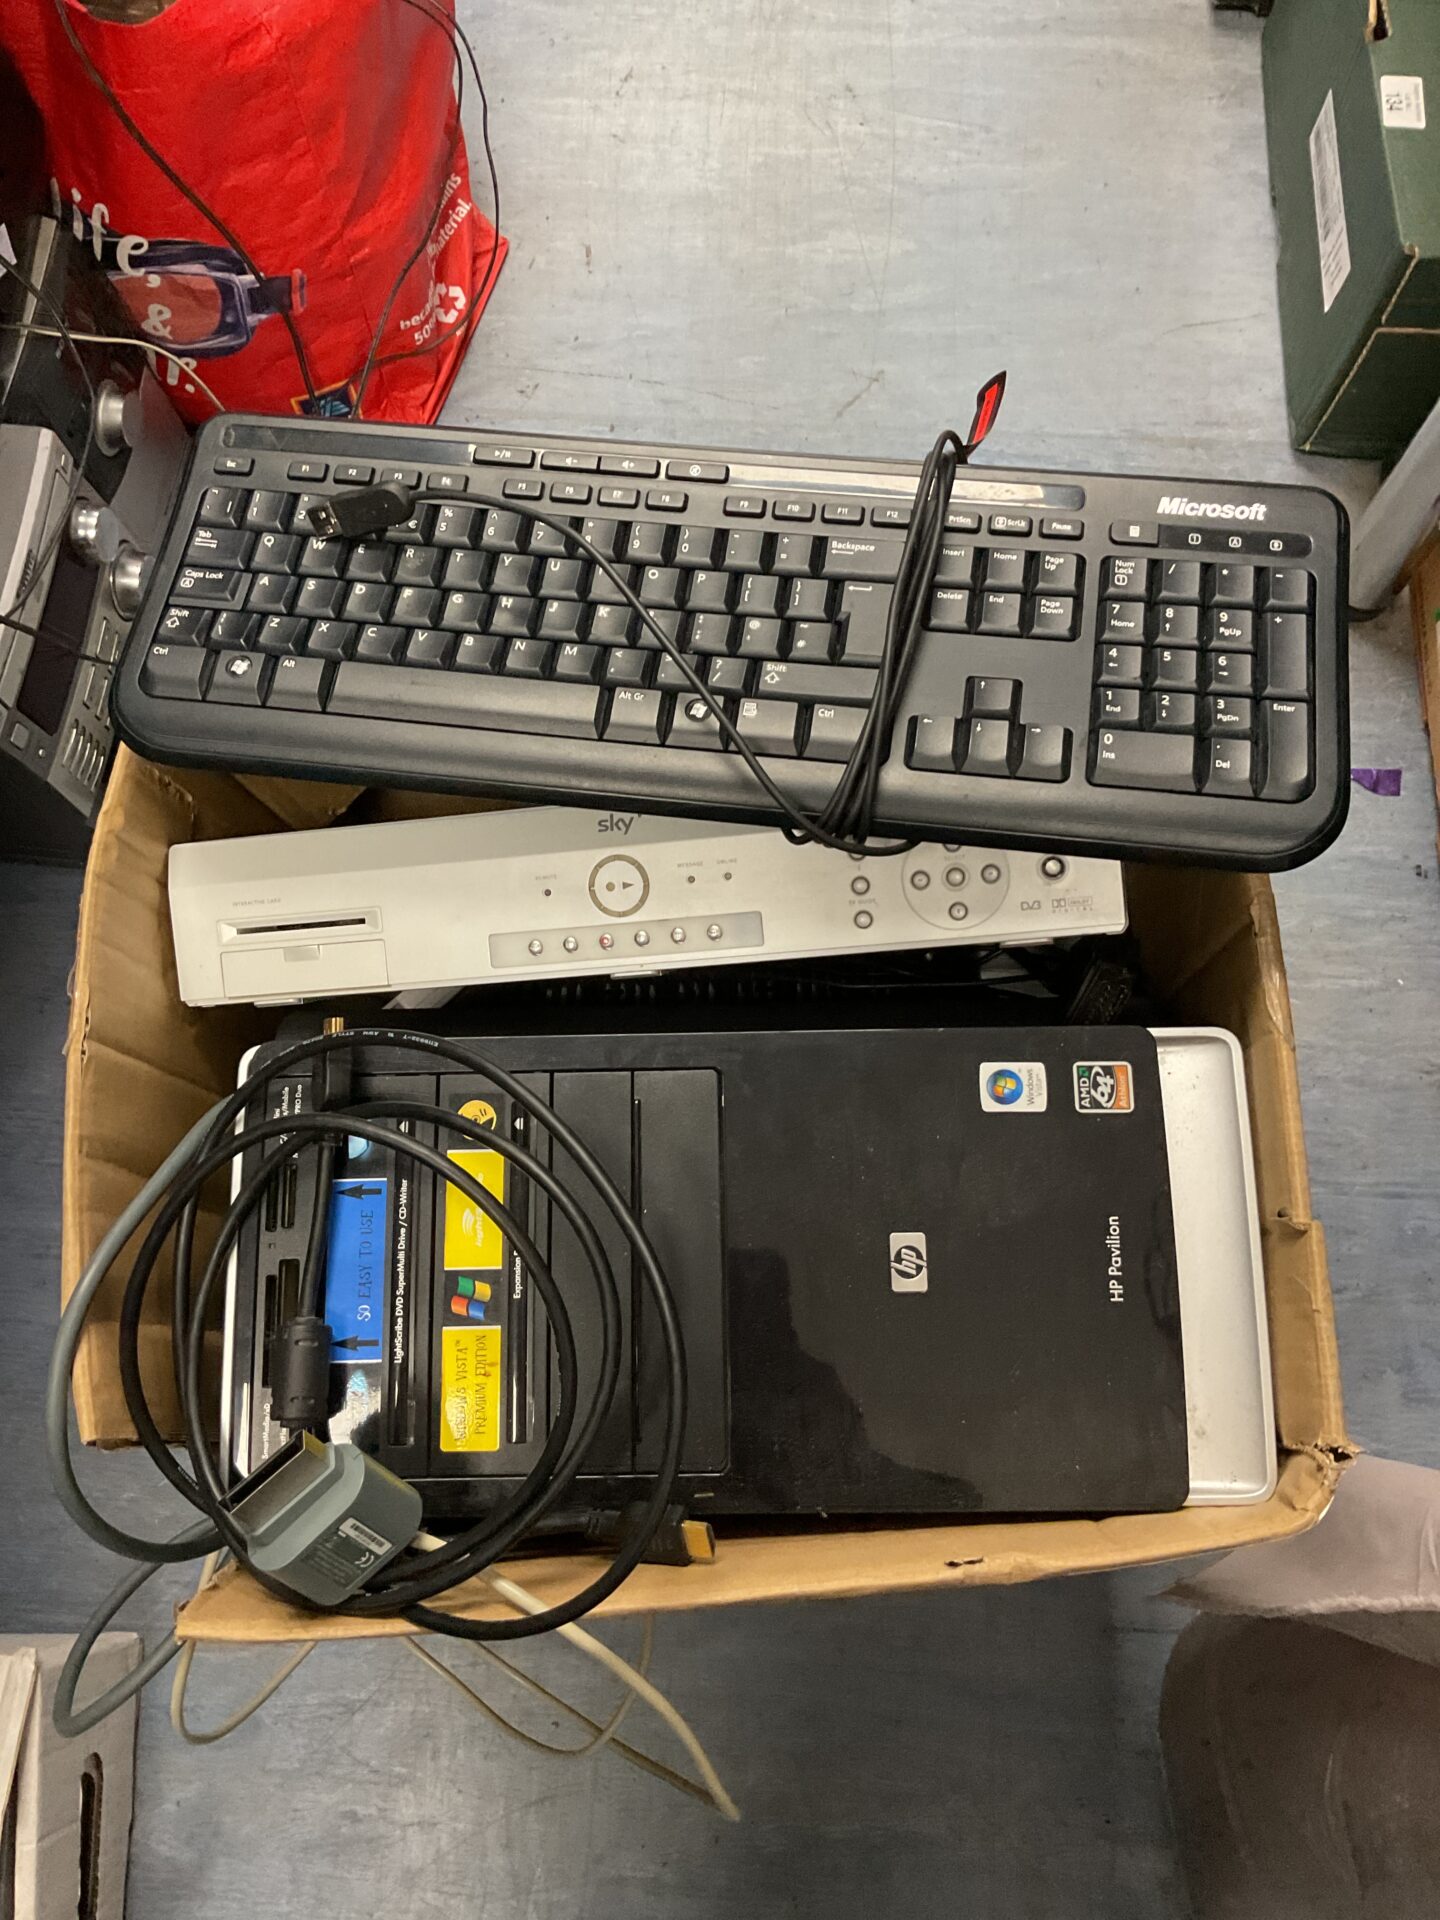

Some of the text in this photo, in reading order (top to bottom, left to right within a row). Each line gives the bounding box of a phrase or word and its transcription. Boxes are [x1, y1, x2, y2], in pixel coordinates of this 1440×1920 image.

[442, 477, 450, 485] F4
[444, 508, 454, 518] %
[787, 504, 800, 513] F10
[837, 507, 848, 515] F11
[1156, 496, 1267, 521] Microsoft
[298, 510, 306, 520] 2
[886, 510, 898, 518] F12
[948, 514, 972, 525] PrtScn
[440, 522, 446, 531] 5
[488, 526, 494, 536] 6
[1051, 522, 1072, 530] Pause
[199, 530, 212, 538] Tab
[536, 532, 544, 540] 7
[264, 536, 274, 548] Q
[312, 540, 326, 550] W
[633, 540, 640, 548] 9
[832, 540, 876, 552] Backspace
[358, 544, 366, 554] E
[406, 548, 414, 558] R
[682, 544, 689, 552] 0
[943, 548, 965, 557] Insert
[456, 552, 464, 562] T
[504, 556, 512, 566] Y
[994, 552, 1018, 560] Home
[1045, 556, 1064, 565] Page
[550, 561, 560, 571] U
[1044, 562, 1056, 570] Up
[1116, 560, 1136, 568] Num
[185, 570, 224, 580] Caps Lock
[648, 570, 658, 580] O
[1115, 566, 1134, 574] Lock
[260, 576, 270, 586] A
[697, 574, 706, 584] P
[307, 580, 316, 590] S
[354, 584, 366, 594] D
[402, 588, 413, 598] F
[937, 592, 963, 600] Delete
[452, 594, 464, 604] G
[501, 598, 513, 608] H
[989, 596, 1004, 604] End
[1040, 600, 1060, 608] Page
[548, 602, 558, 612] J
[598, 606, 610, 618] K
[1112, 604, 1120, 614] 7
[170, 608, 190, 617] Shift
[1166, 608, 1174, 618] 8
[1220, 612, 1228, 622] 9
[270, 618, 280, 628] Z
[318, 622, 330, 632] X
[750, 620, 760, 630] @
[1110, 619, 1135, 628] Home
[368, 628, 377, 637] C
[418, 632, 428, 641] V
[1219, 627, 1242, 636] PgUp
[464, 636, 474, 646] B
[514, 641, 526, 650] N
[153, 647, 168, 656] Ctrl
[564, 646, 578, 656] M
[1109, 648, 1118, 658] 4
[1164, 652, 1172, 661] 5
[1218, 656, 1227, 666] 6
[282, 660, 296, 668] Alt
[766, 664, 786, 672] Shift
[618, 692, 632, 700] Alt
[1162, 695, 1170, 705] 2
[1106, 704, 1121, 713] End
[1217, 700, 1225, 710] 3
[1273, 704, 1296, 712] Enter
[818, 709, 834, 718] Ctrl
[1216, 714, 1239, 723] PgDn
[1104, 734, 1114, 744] 0
[1102, 750, 1116, 760] Ins
[1215, 760, 1230, 769] Del
[598, 813, 634, 835] sky
[1026, 1068, 1034, 1106] Windows
[1080, 1077, 1090, 1108] AMD
[398, 1178, 408, 1220] CD-Writer
[398, 1228, 406, 1249] Drive
[890, 1248, 926, 1275] hp
[1105, 1215, 1124, 1302] HP Pavilion
[356, 1210, 374, 1322] SO EASY TO USE
[396, 1250, 406, 1295] SuperMulti
[512, 1256, 522, 1299] Expansion
[395, 1296, 404, 1316] DVD
[394, 1318, 404, 1364] LightScribe
[474, 1334, 488, 1434] PREMIUM EDITION
